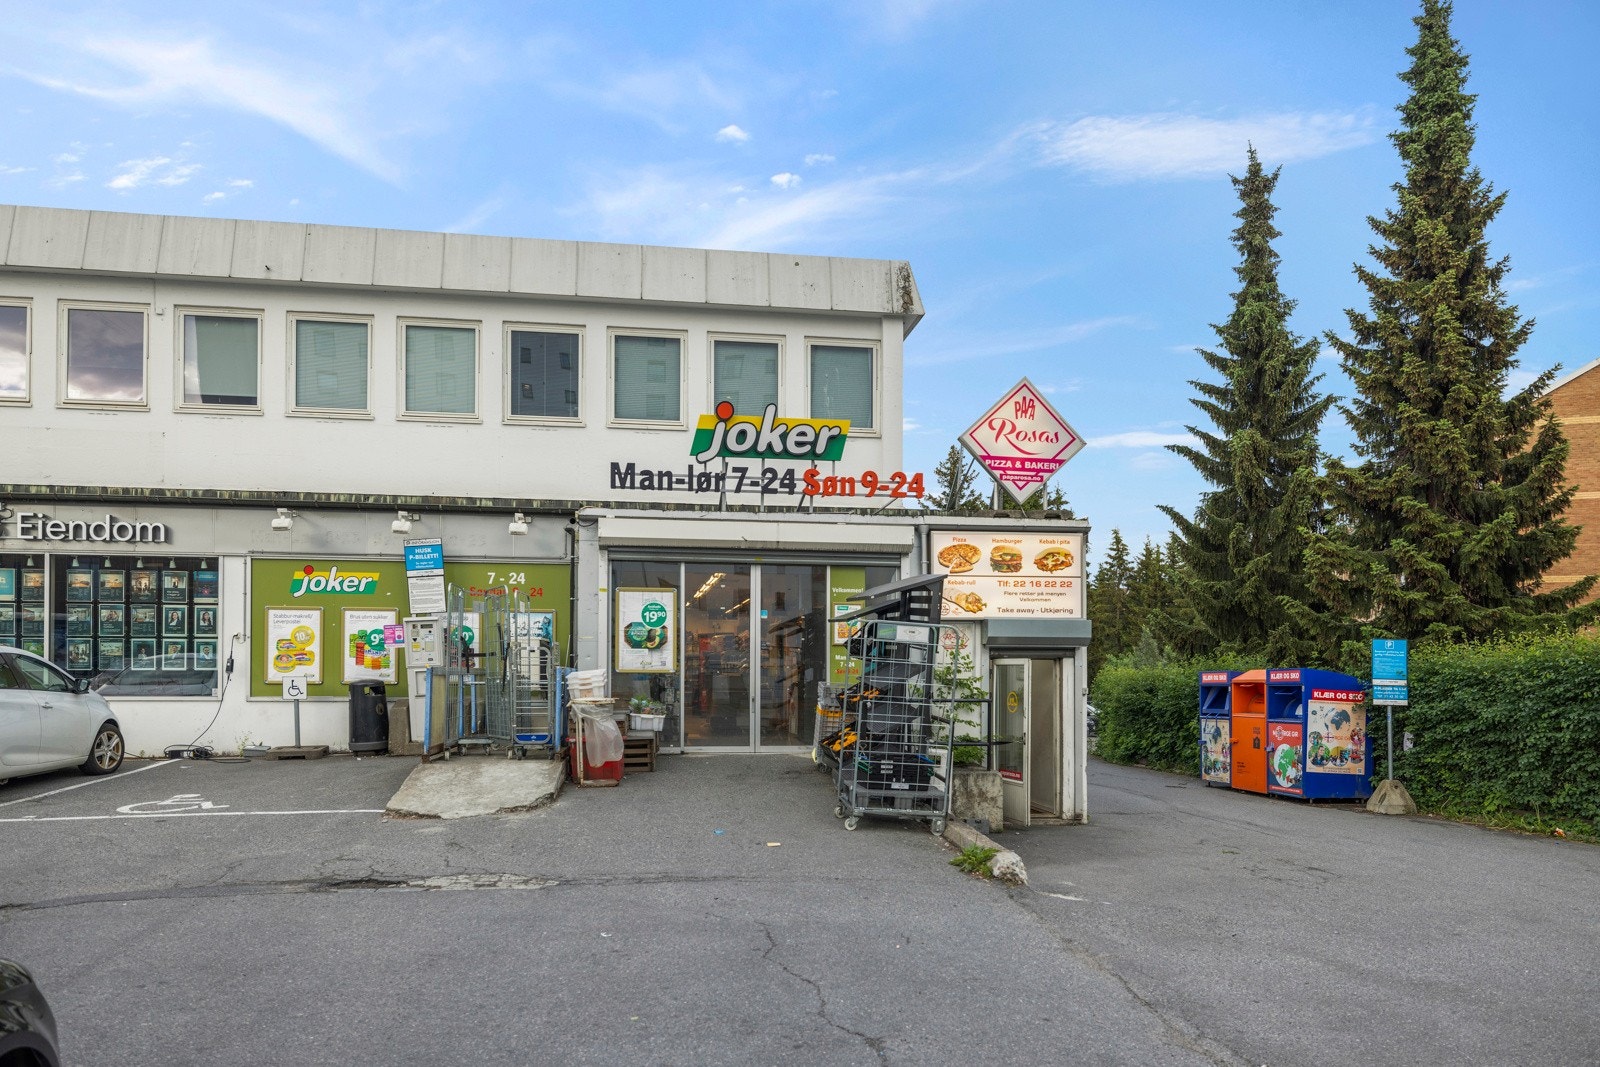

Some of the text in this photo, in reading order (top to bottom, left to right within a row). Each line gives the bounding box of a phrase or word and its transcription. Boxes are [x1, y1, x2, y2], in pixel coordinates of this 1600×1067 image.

[1014, 396, 1036, 421] PAPA
[696, 401, 841, 464] joker
[987, 417, 1060, 456] Rosas
[610, 461, 797, 494] Man-lør 7-24
[985, 459, 1060, 470] PIZZA & BAKERI
[802, 466, 925, 499] Søn 9-24
[16, 512, 166, 542] Eiendom
[293, 564, 374, 598] joker
[488, 572, 496, 584] 7
[508, 572, 526, 584] 24
[530, 588, 543, 596] 24
